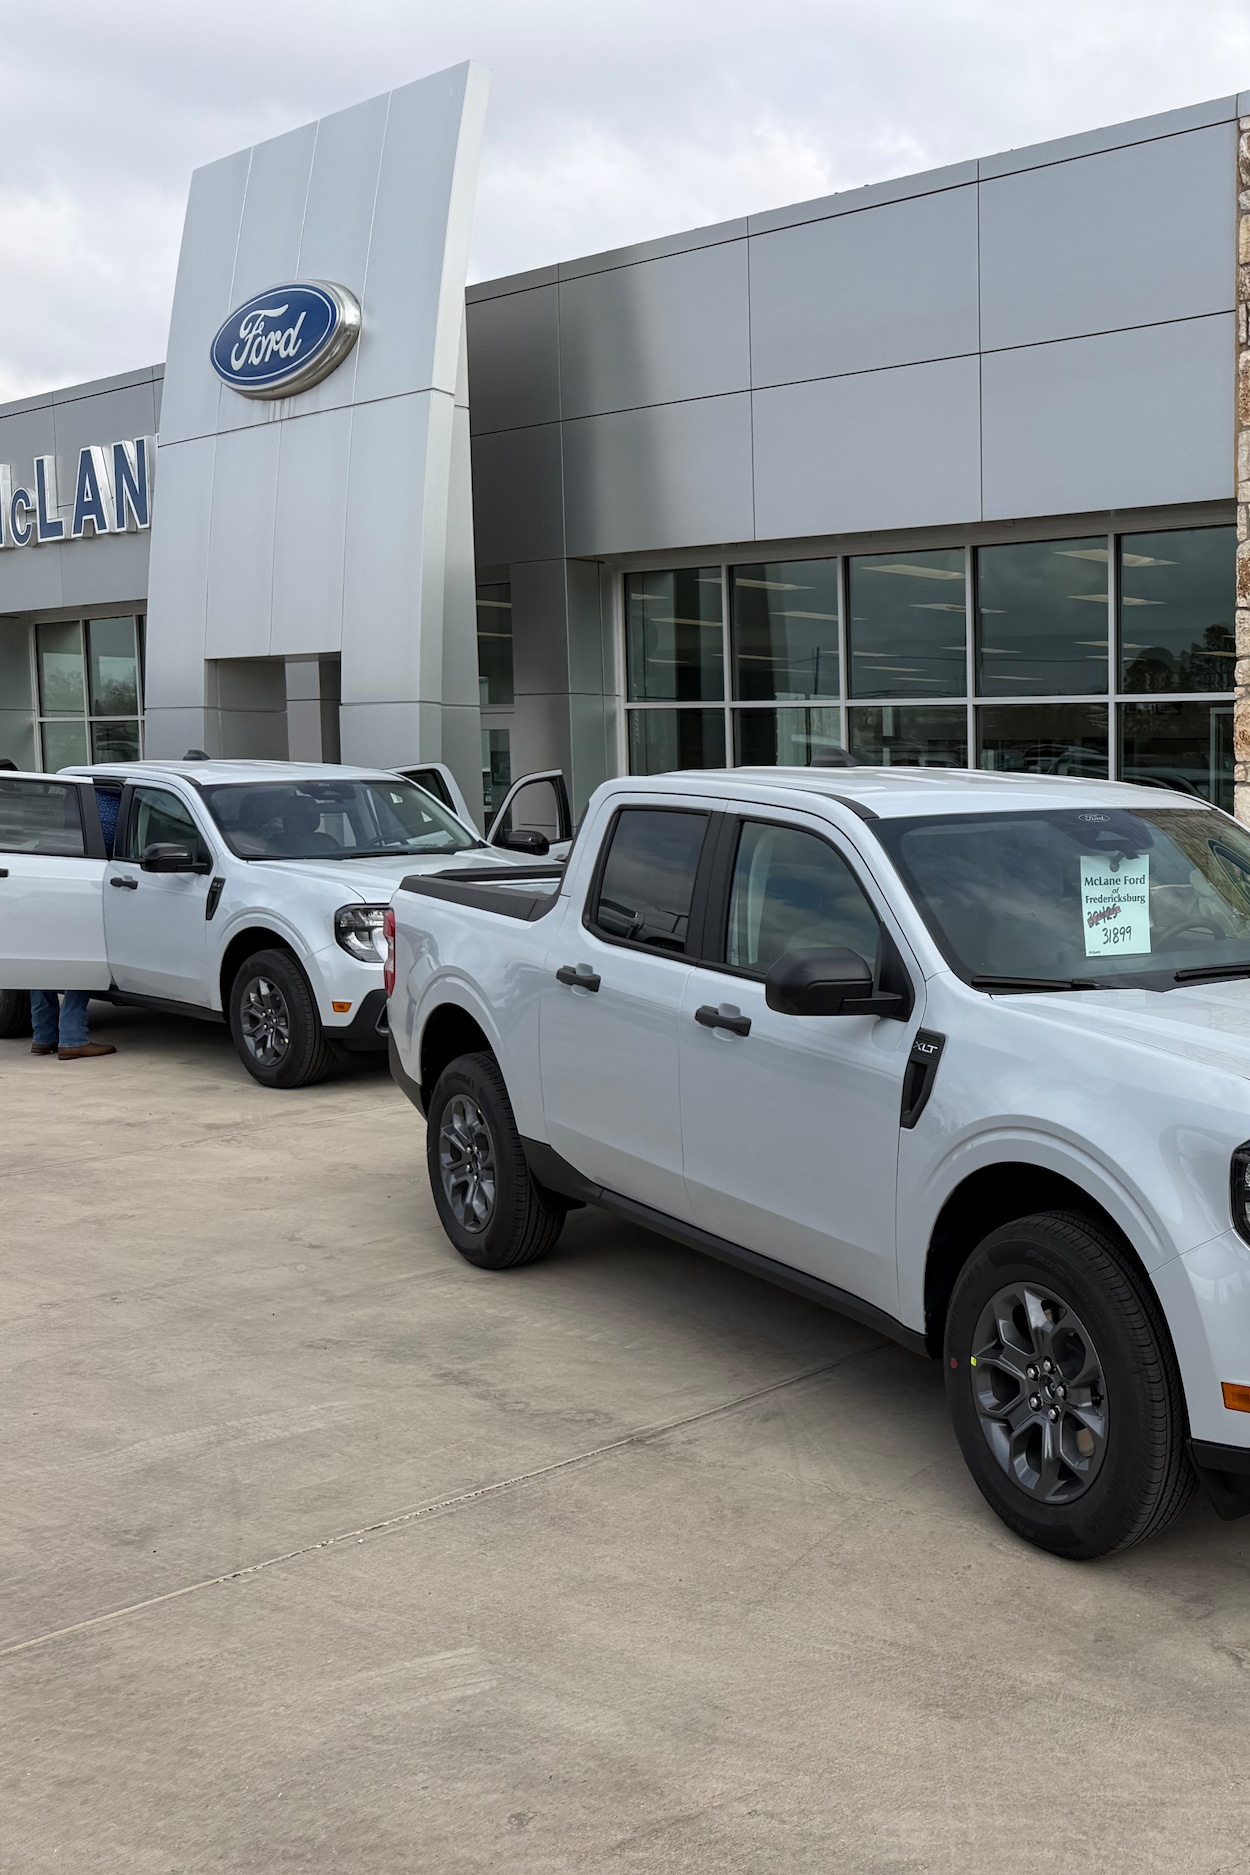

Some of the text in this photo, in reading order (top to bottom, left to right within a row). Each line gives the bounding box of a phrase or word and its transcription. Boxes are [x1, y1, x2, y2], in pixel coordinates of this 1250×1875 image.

[231, 304, 306, 371] Ford
[0, 434, 158, 548] cLAN
[1084, 874, 1146, 887] McLane Ford
[1111, 886, 1120, 894] of
[1085, 893, 1146, 905] Fredericksburg
[1102, 925, 1132, 945] 31899
[913, 1041, 939, 1054] XLT
